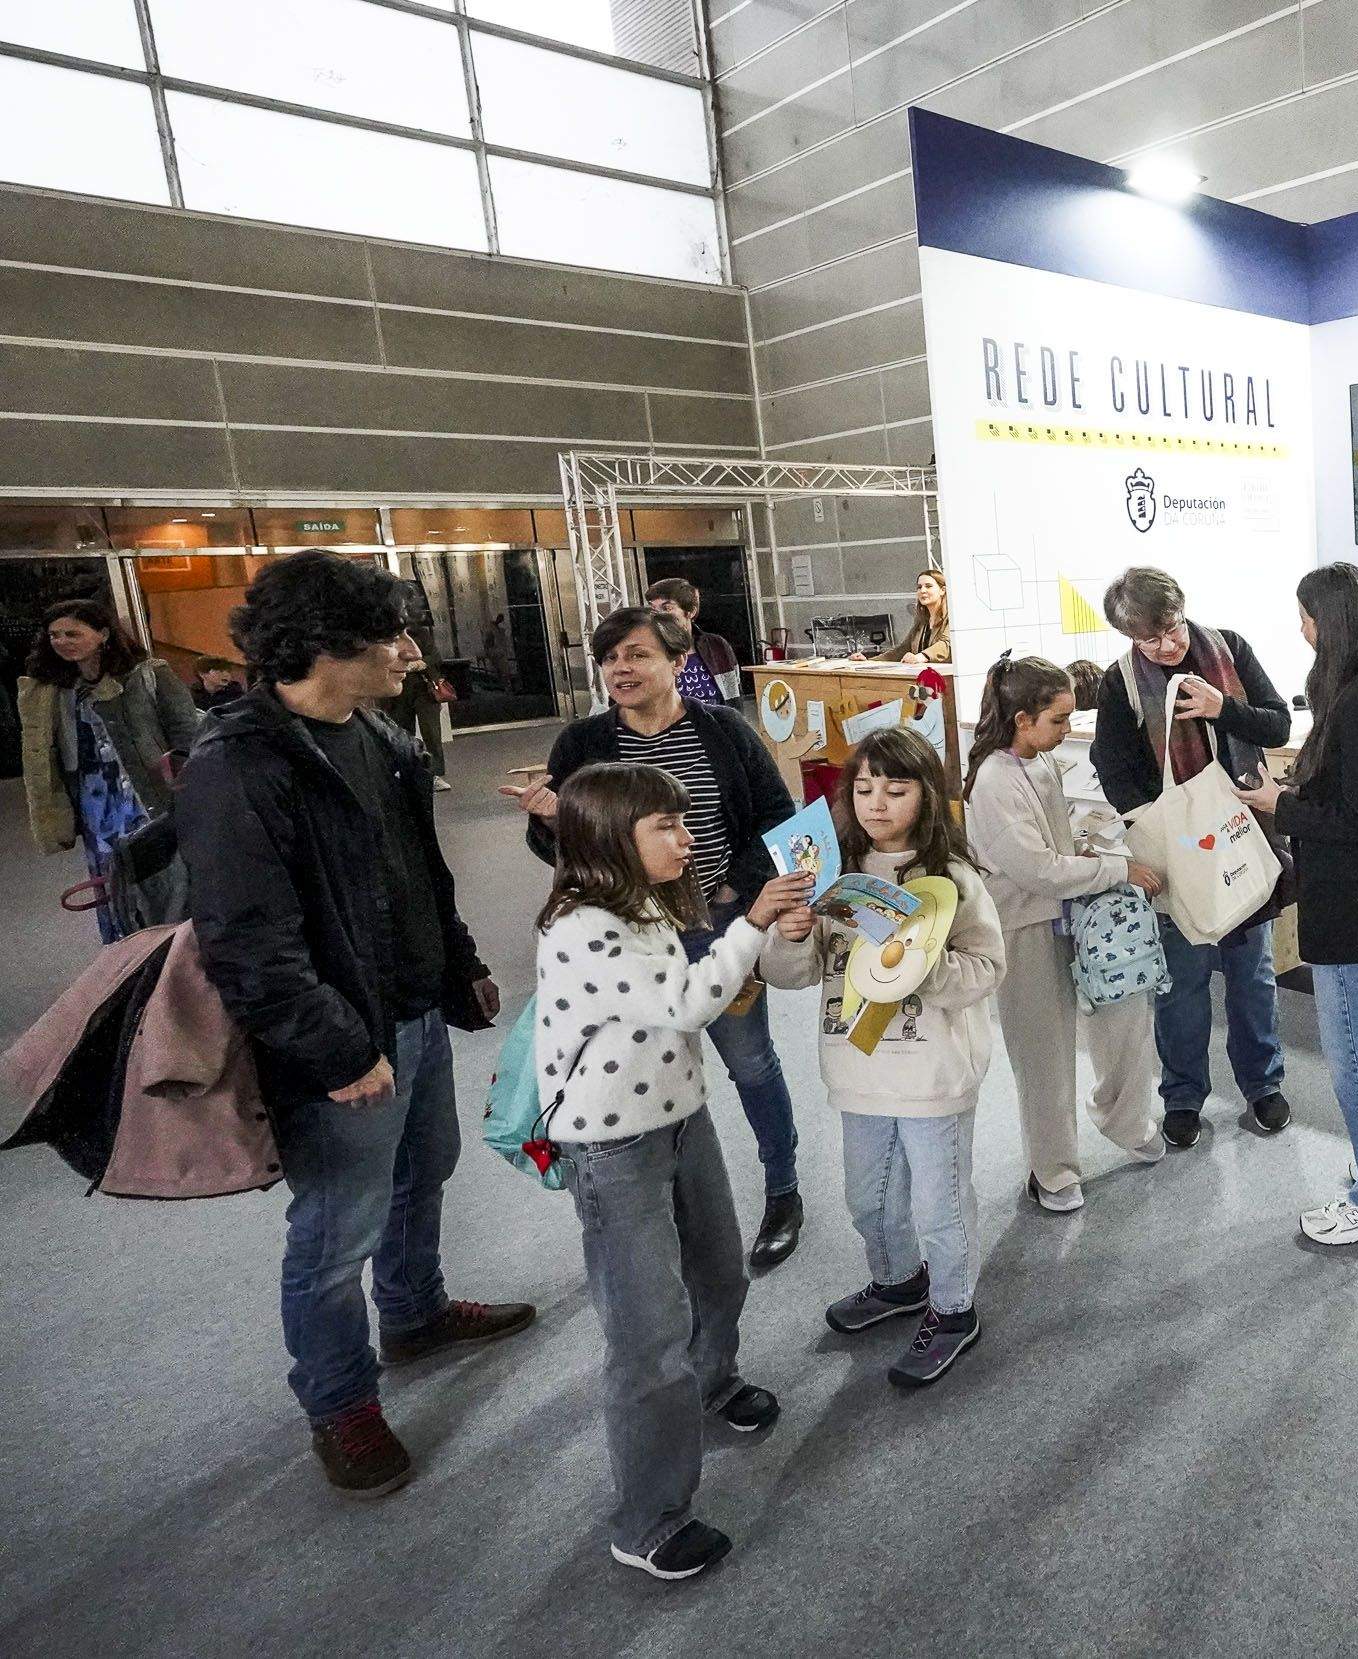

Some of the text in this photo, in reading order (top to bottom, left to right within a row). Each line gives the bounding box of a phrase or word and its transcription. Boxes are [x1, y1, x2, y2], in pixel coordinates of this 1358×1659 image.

[982, 336, 1275, 428] REDE CULTURAL
[1163, 494, 1226, 512] Deputación
[303, 522, 340, 532] SAÍDA
